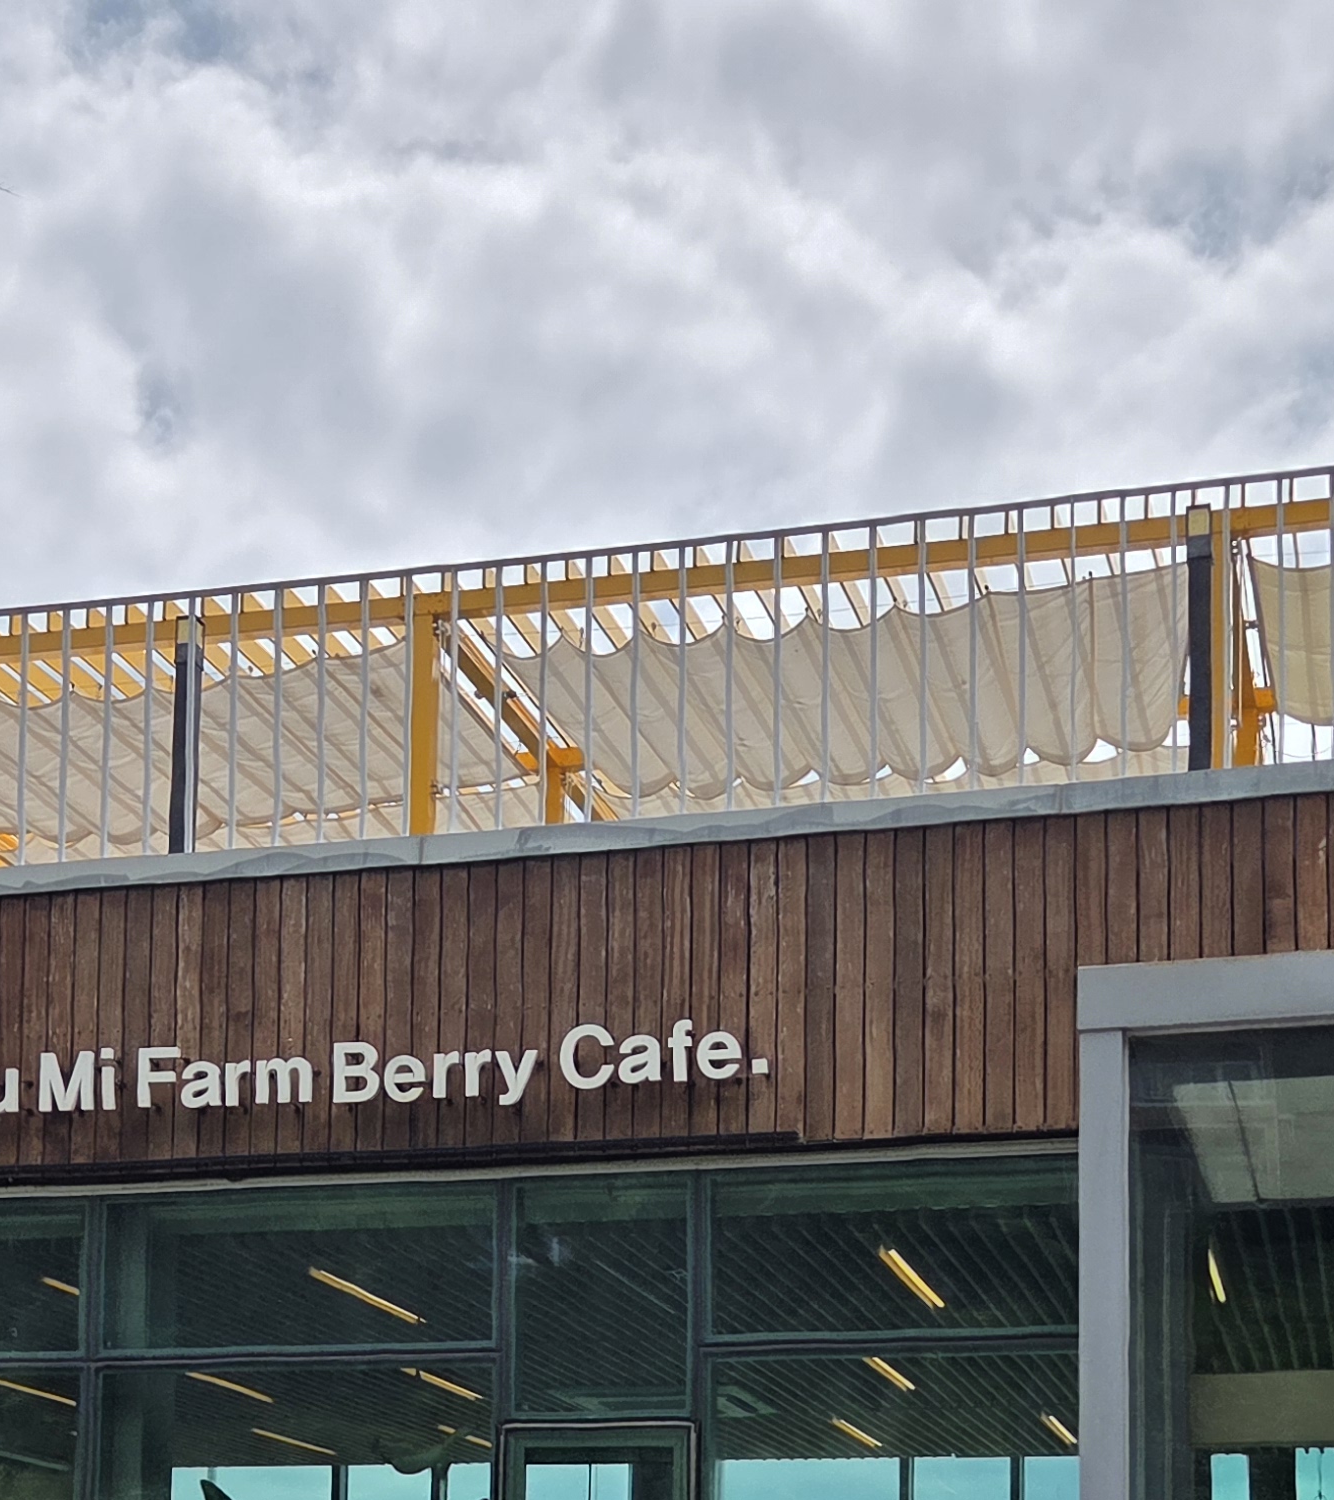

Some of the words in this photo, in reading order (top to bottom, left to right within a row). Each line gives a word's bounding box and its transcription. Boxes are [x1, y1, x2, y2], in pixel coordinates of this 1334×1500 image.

[38, 1047, 117, 1112] Mi
[137, 1046, 314, 1108] Farm
[332, 1041, 538, 1106] Berry
[559, 1019, 770, 1090] Cafe.
